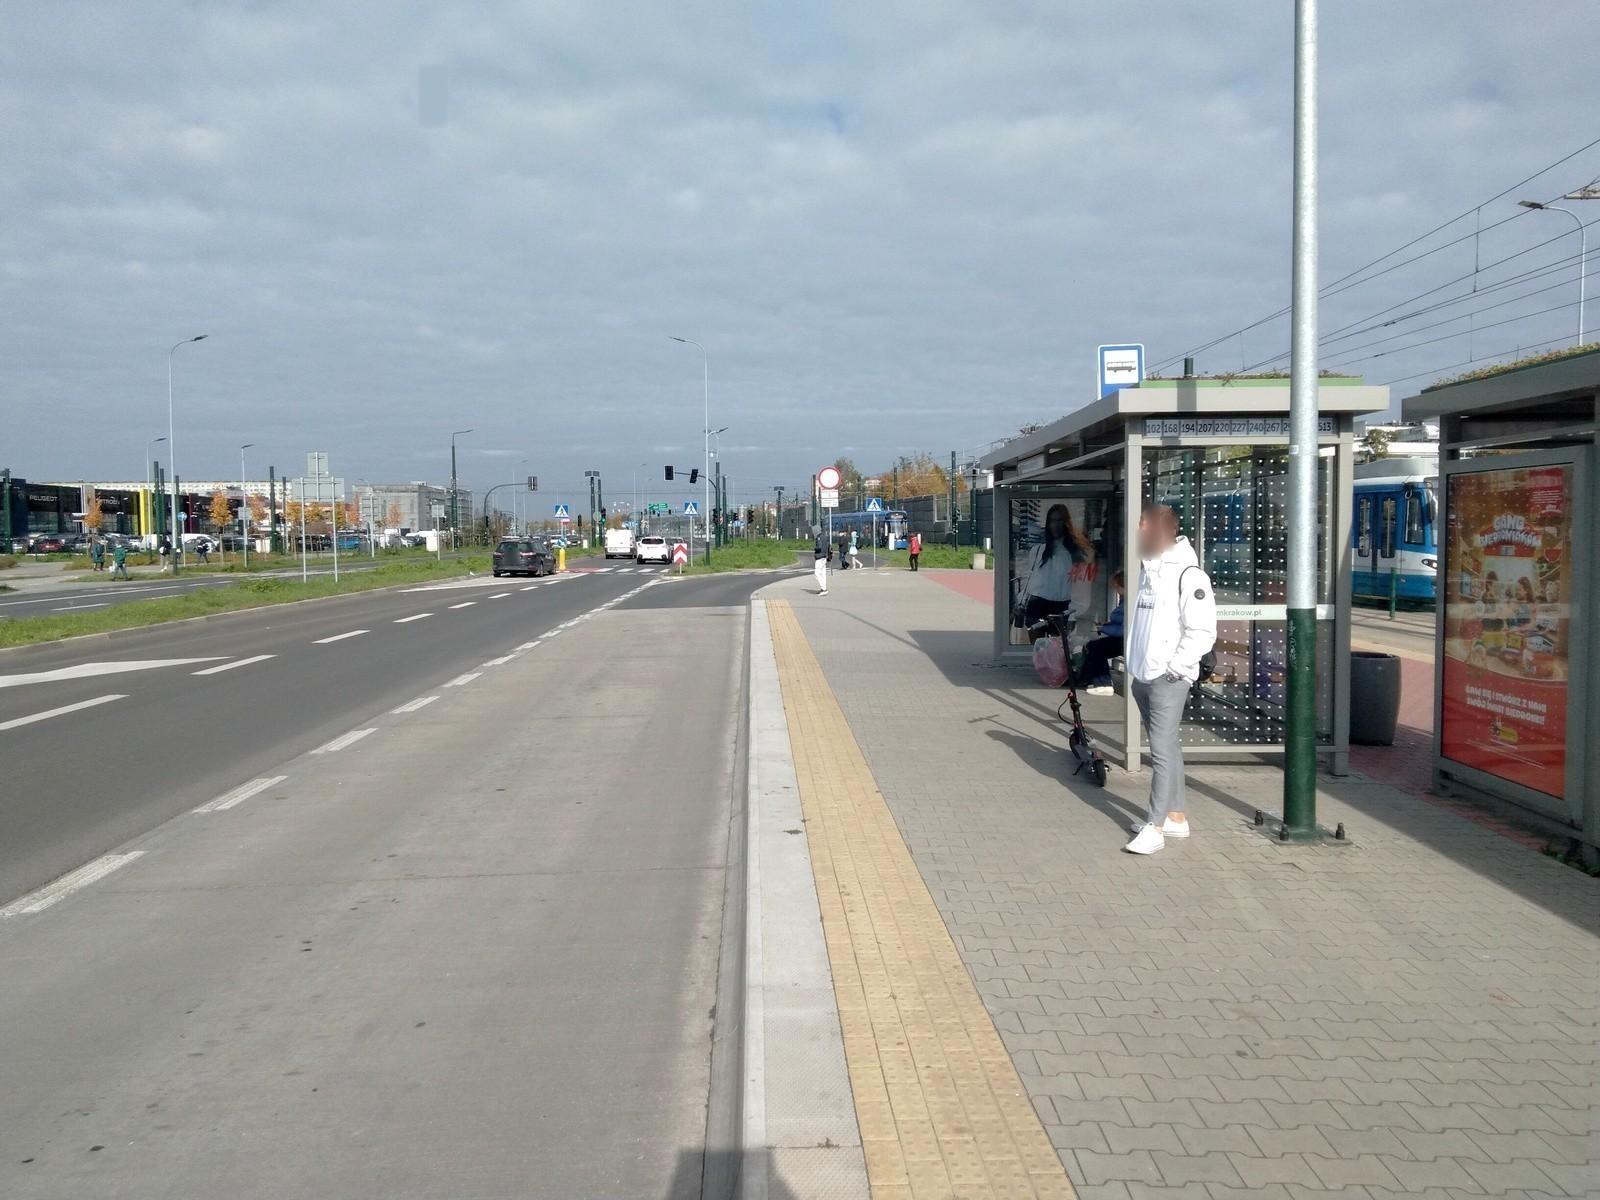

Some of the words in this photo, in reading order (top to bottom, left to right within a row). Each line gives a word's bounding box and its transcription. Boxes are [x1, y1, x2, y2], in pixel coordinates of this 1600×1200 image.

[1146, 423, 1161, 433] 102
[1164, 423, 1178, 433] 168
[1181, 423, 1195, 433] 194
[1198, 423, 1213, 433] 207
[1215, 423, 1230, 433] 220
[1232, 422, 1247, 432] 227
[1249, 422, 1264, 432] 240
[1265, 422, 1280, 432] 267
[1215, 609, 1264, 617] mkrakow.pl
